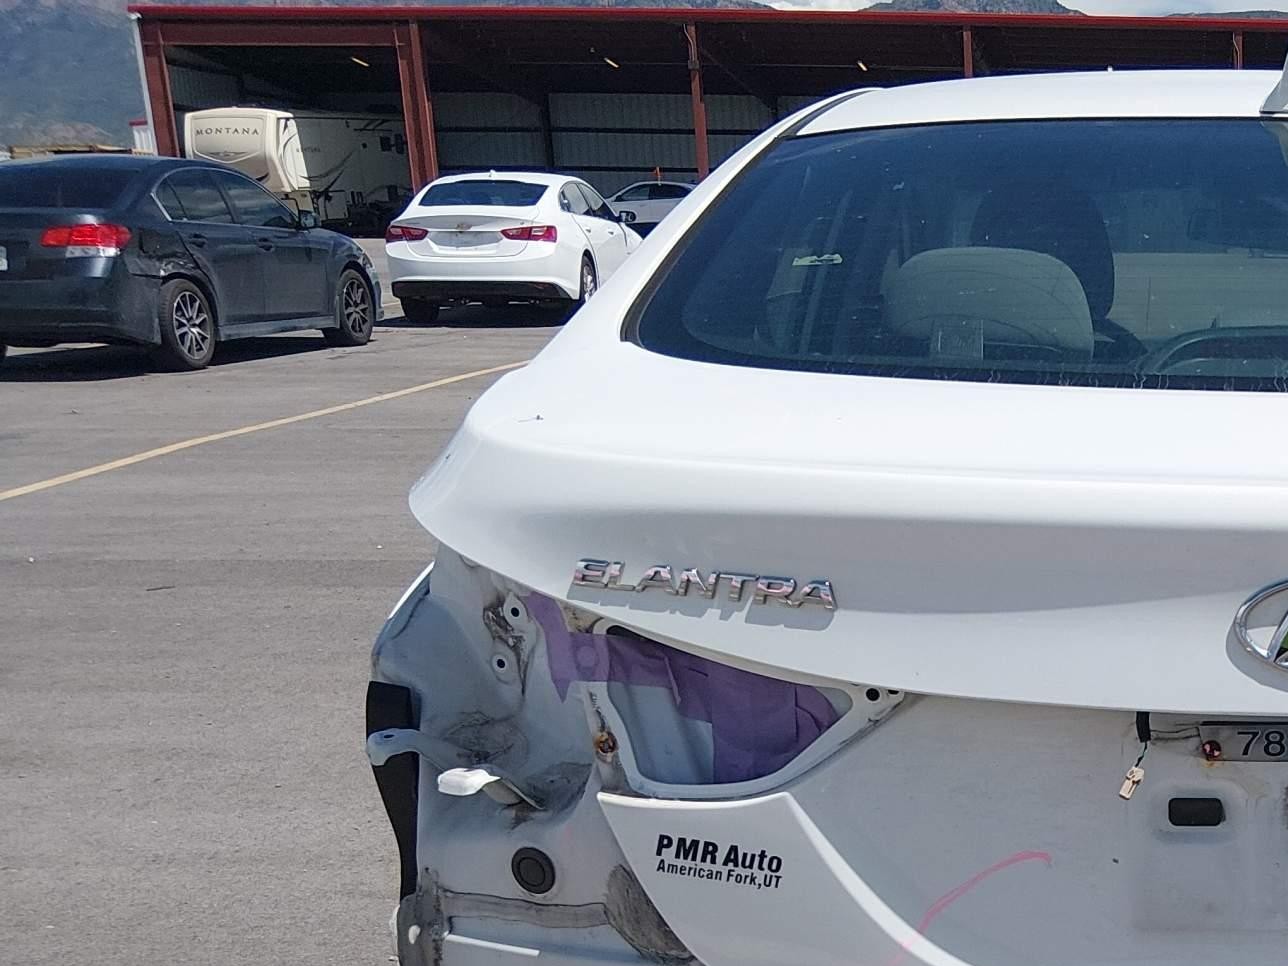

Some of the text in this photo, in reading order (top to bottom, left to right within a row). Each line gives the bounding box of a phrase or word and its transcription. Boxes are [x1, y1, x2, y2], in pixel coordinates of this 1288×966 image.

[195, 127, 260, 136] MONTANA
[573, 558, 838, 610] ELANTRA
[656, 834, 782, 873] PMR Auto
[656, 859, 723, 881] American
